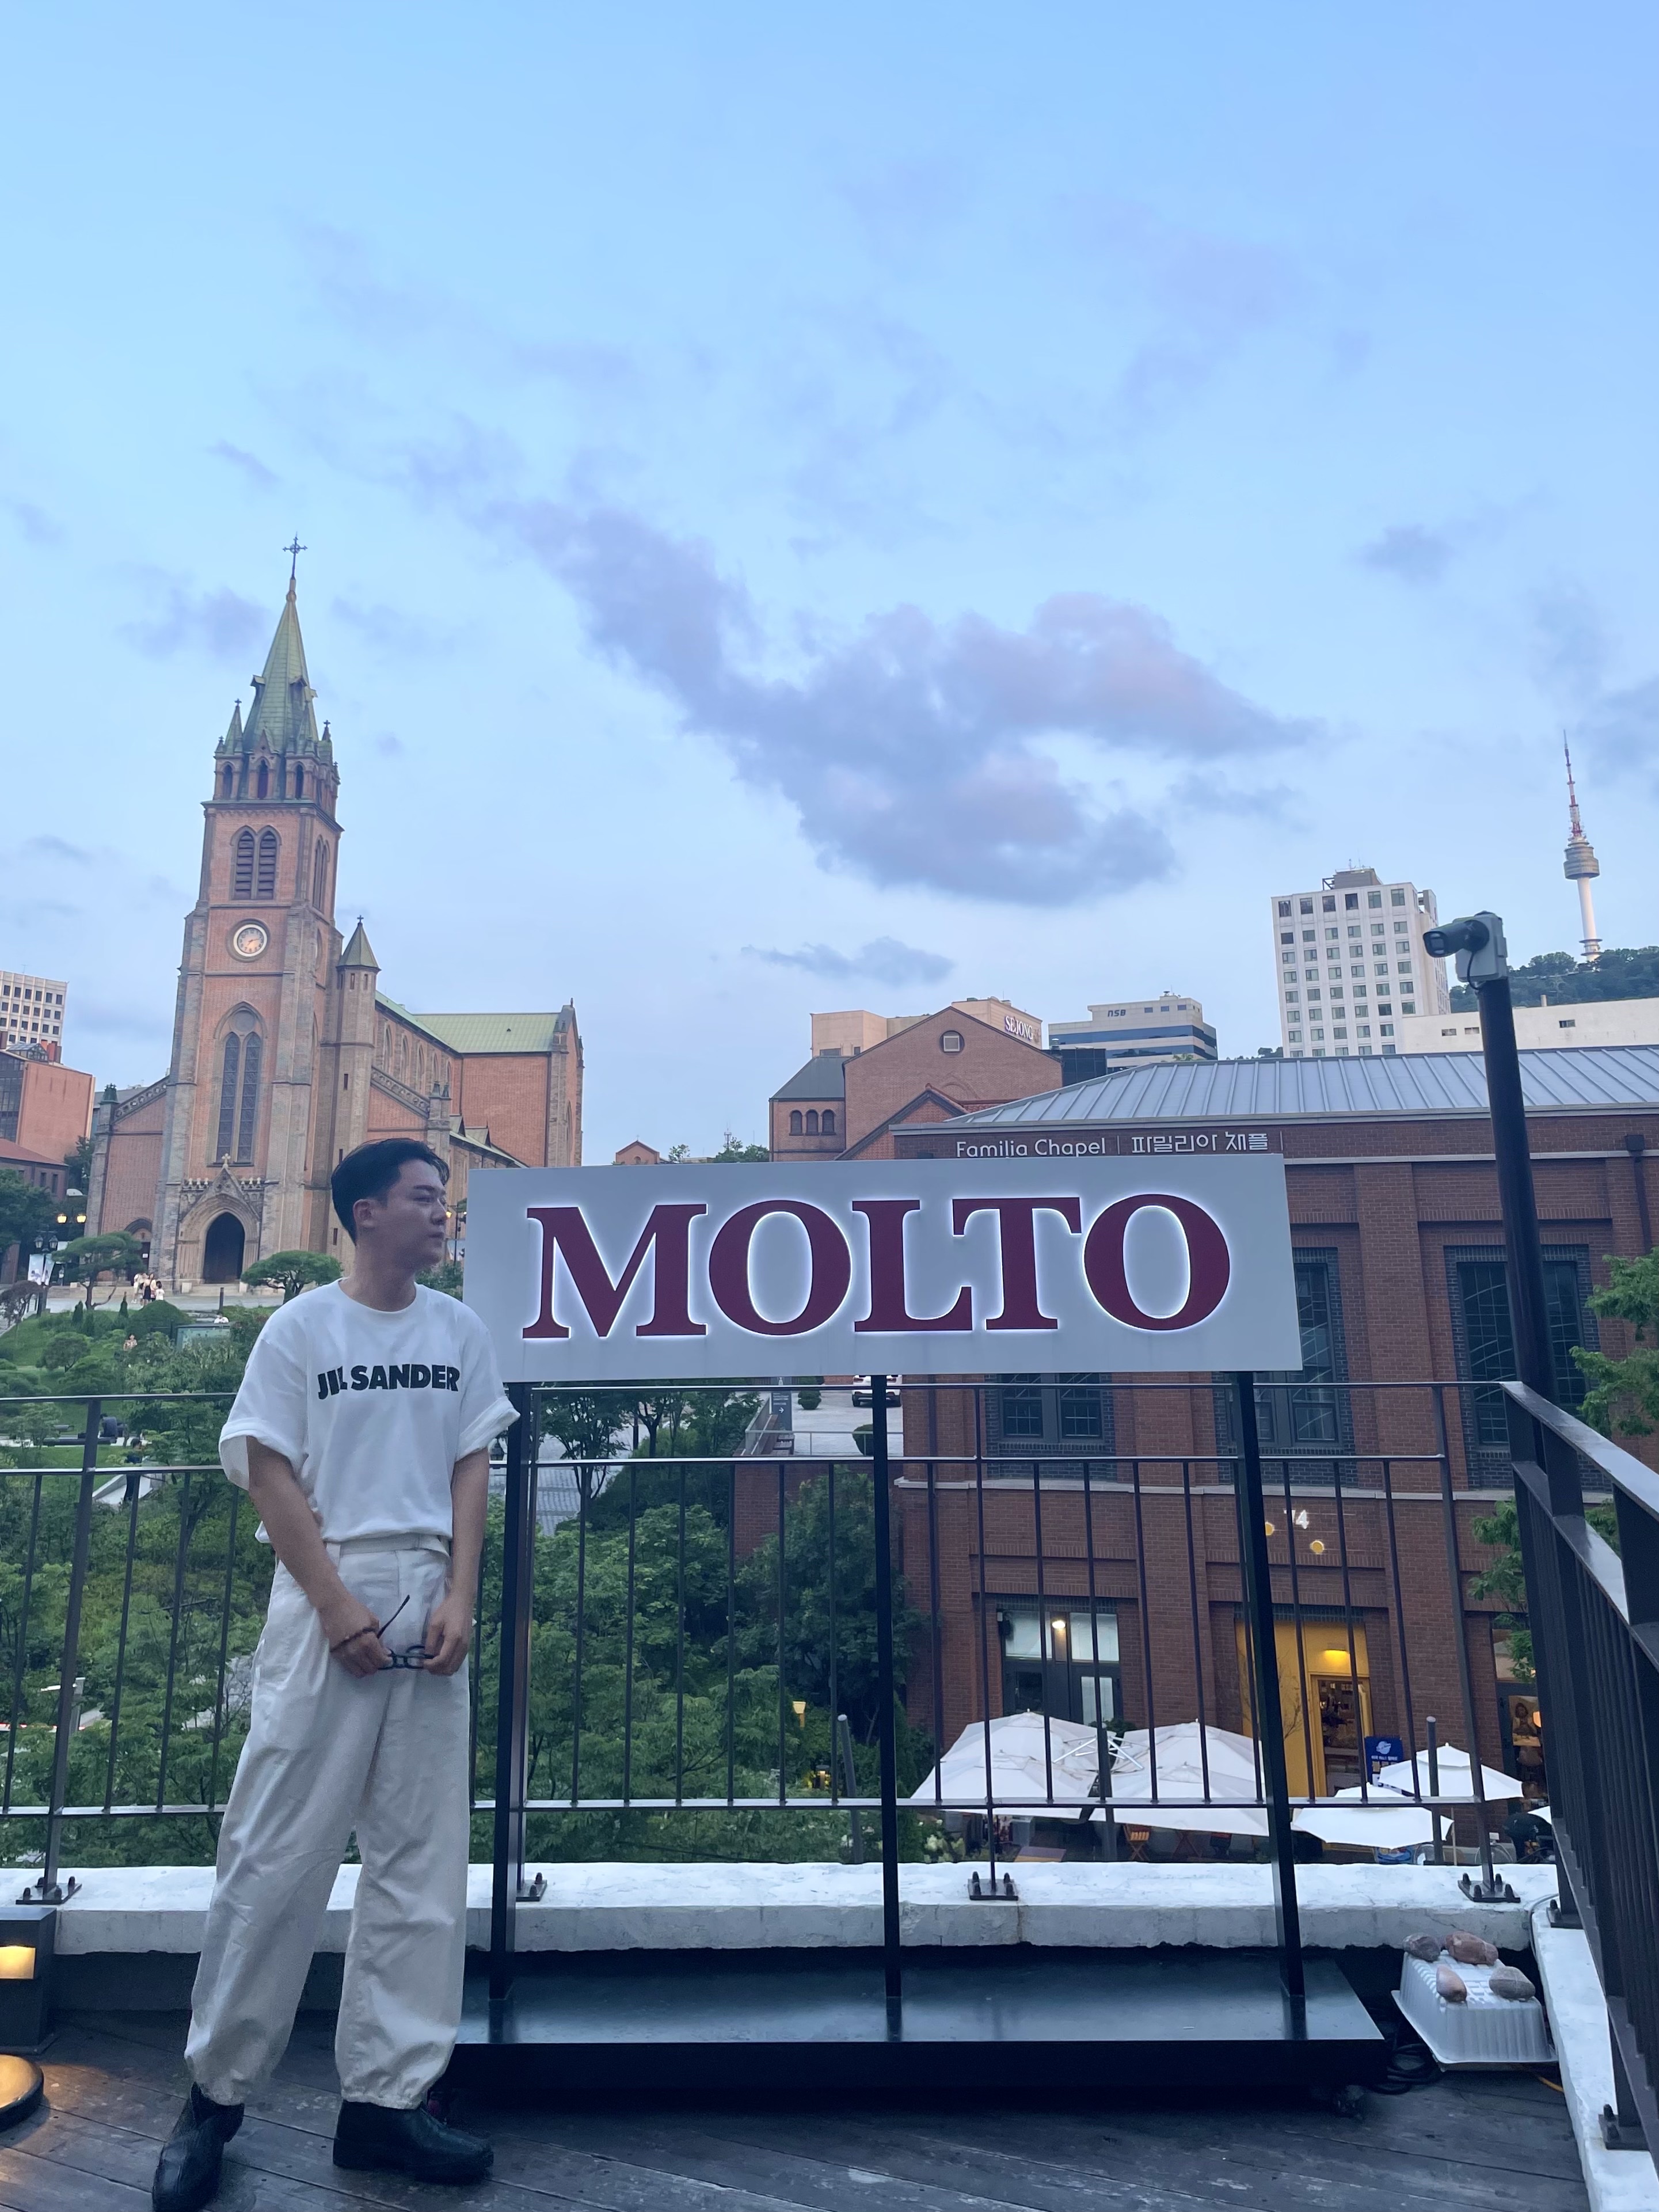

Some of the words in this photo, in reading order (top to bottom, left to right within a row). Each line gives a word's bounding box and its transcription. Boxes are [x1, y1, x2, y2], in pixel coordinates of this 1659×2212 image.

[1004, 1016, 1033, 1040] SEJONG
[956, 1140, 1028, 1158] Familia
[1034, 1137, 1105, 1157] Chapel
[1132, 1134, 1217, 1153] 파밀리아
[1225, 1131, 1268, 1151] 채플
[522, 1193, 1231, 1339] MOLTO
[317, 1366, 348, 1400] JIL
[351, 1364, 461, 1392] SANDER
